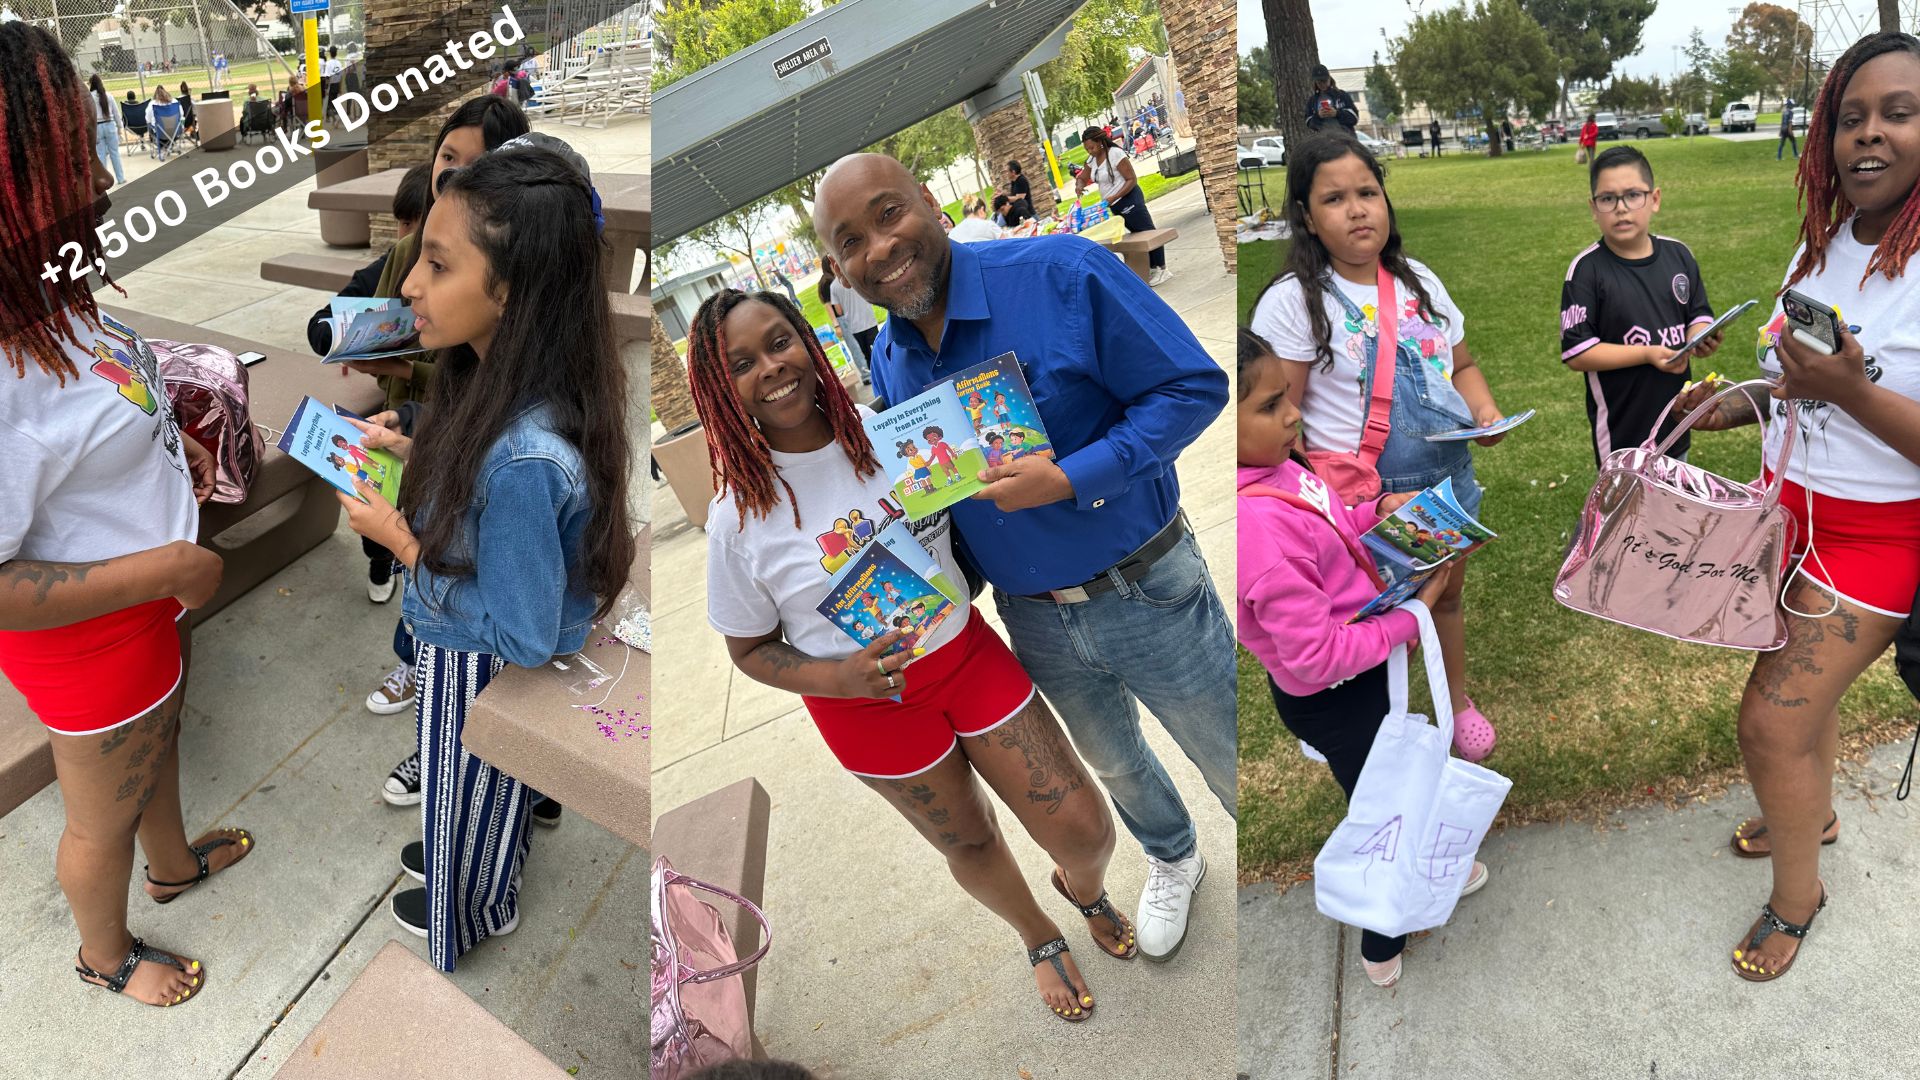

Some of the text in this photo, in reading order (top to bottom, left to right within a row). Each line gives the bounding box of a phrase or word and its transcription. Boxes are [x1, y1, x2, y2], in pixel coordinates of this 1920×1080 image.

[778, 42, 828, 74] SHELTER AREA #1
[300, 437, 313, 457] Loyalty
[307, 412, 323, 437] Everything
[873, 416, 898, 432] Loyalty
[904, 396, 942, 418] Everything
[895, 423, 912, 433] from
[911, 418, 917, 426] A
[916, 415, 924, 424] to
[1623, 535, 1760, 584] It's God For Me
[830, 563, 877, 615] I Am Affirmations
[1353, 814, 1402, 862] A
